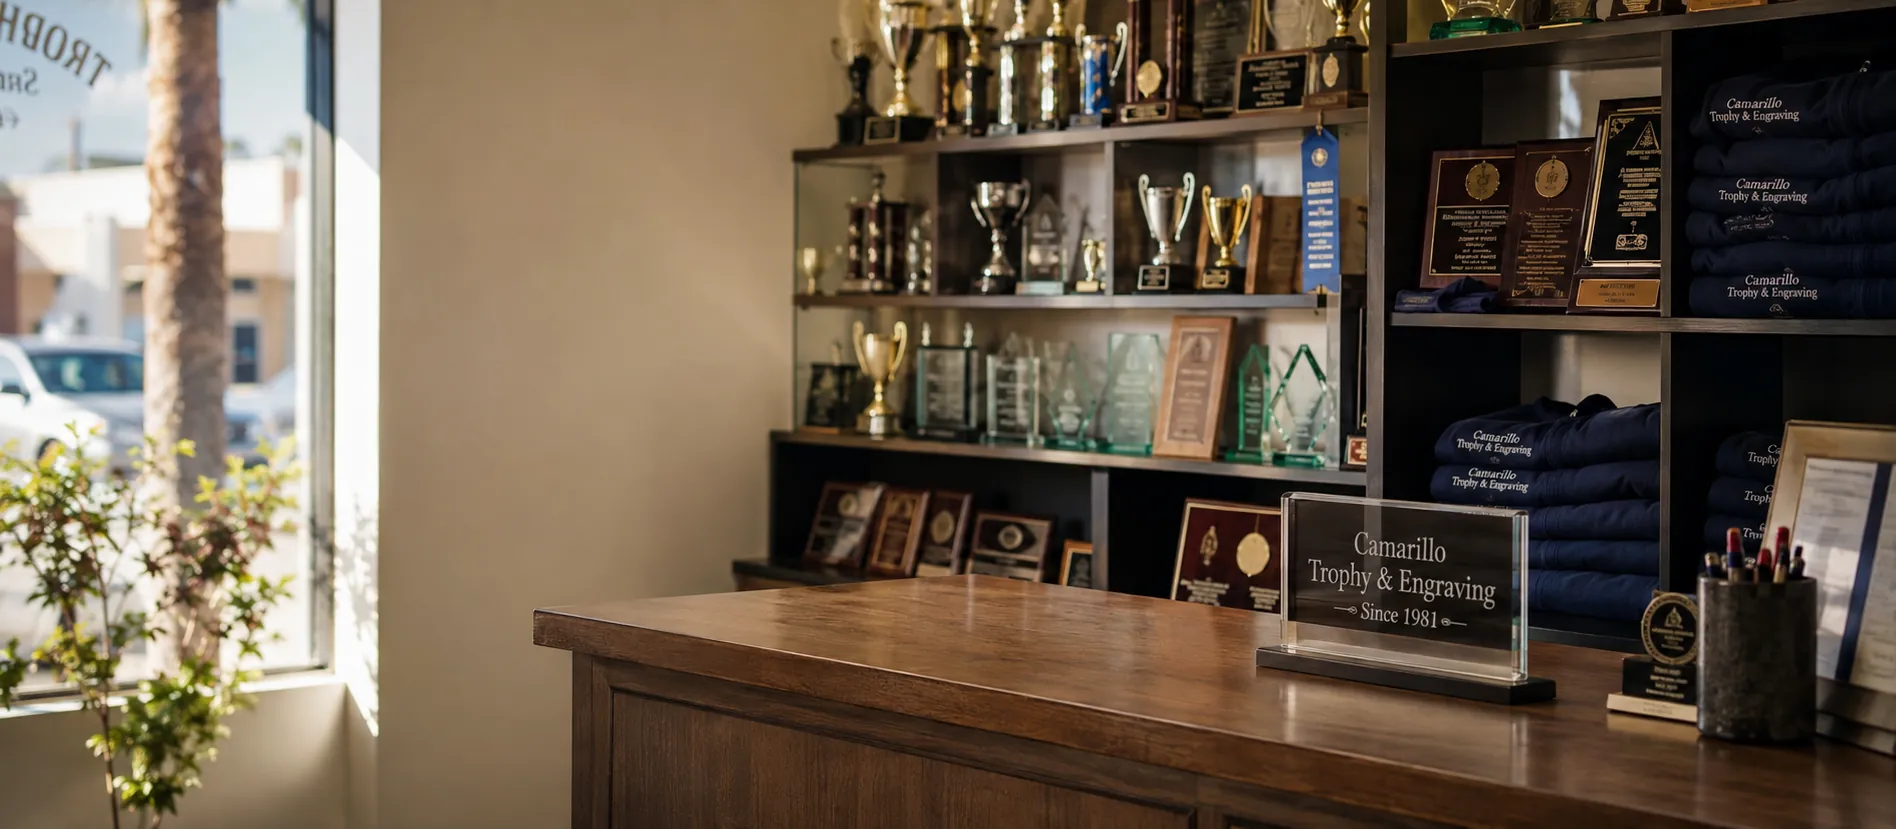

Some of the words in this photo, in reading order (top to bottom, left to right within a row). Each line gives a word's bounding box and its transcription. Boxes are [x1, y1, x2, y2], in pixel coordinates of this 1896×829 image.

[1726, 97, 1782, 109] Camarillo
[1709, 110, 1740, 123] Trophy
[1742, 111, 1751, 121] &
[1753, 109, 1800, 123] Engraving
[1736, 178, 1790, 190] Camarillo
[1719, 190, 1749, 203] Trophy
[1751, 191, 1760, 201] &
[1762, 191, 1808, 205] Engraving
[1745, 273, 1800, 286] Camarillo
[1727, 287, 1759, 300] Trophy
[1760, 287, 1769, 297] &
[1772, 287, 1818, 300] Engraving
[1473, 430, 1520, 444] Camarillo
[1457, 438, 1483, 452] Trophy
[1485, 442, 1492, 452] &
[1494, 443, 1532, 457] Engraving
[1468, 467, 1517, 480] Camarillo
[1452, 476, 1478, 490] Trophy
[1479, 479, 1487, 489] &
[1489, 480, 1529, 494] Engraving
[1354, 531, 1446, 563] Camarillo
[1308, 558, 1372, 595] Trophy
[1376, 566, 1393, 591] &
[1398, 569, 1496, 610] Engraving
[1360, 602, 1399, 624] Since
[1403, 607, 1438, 629] 1981
